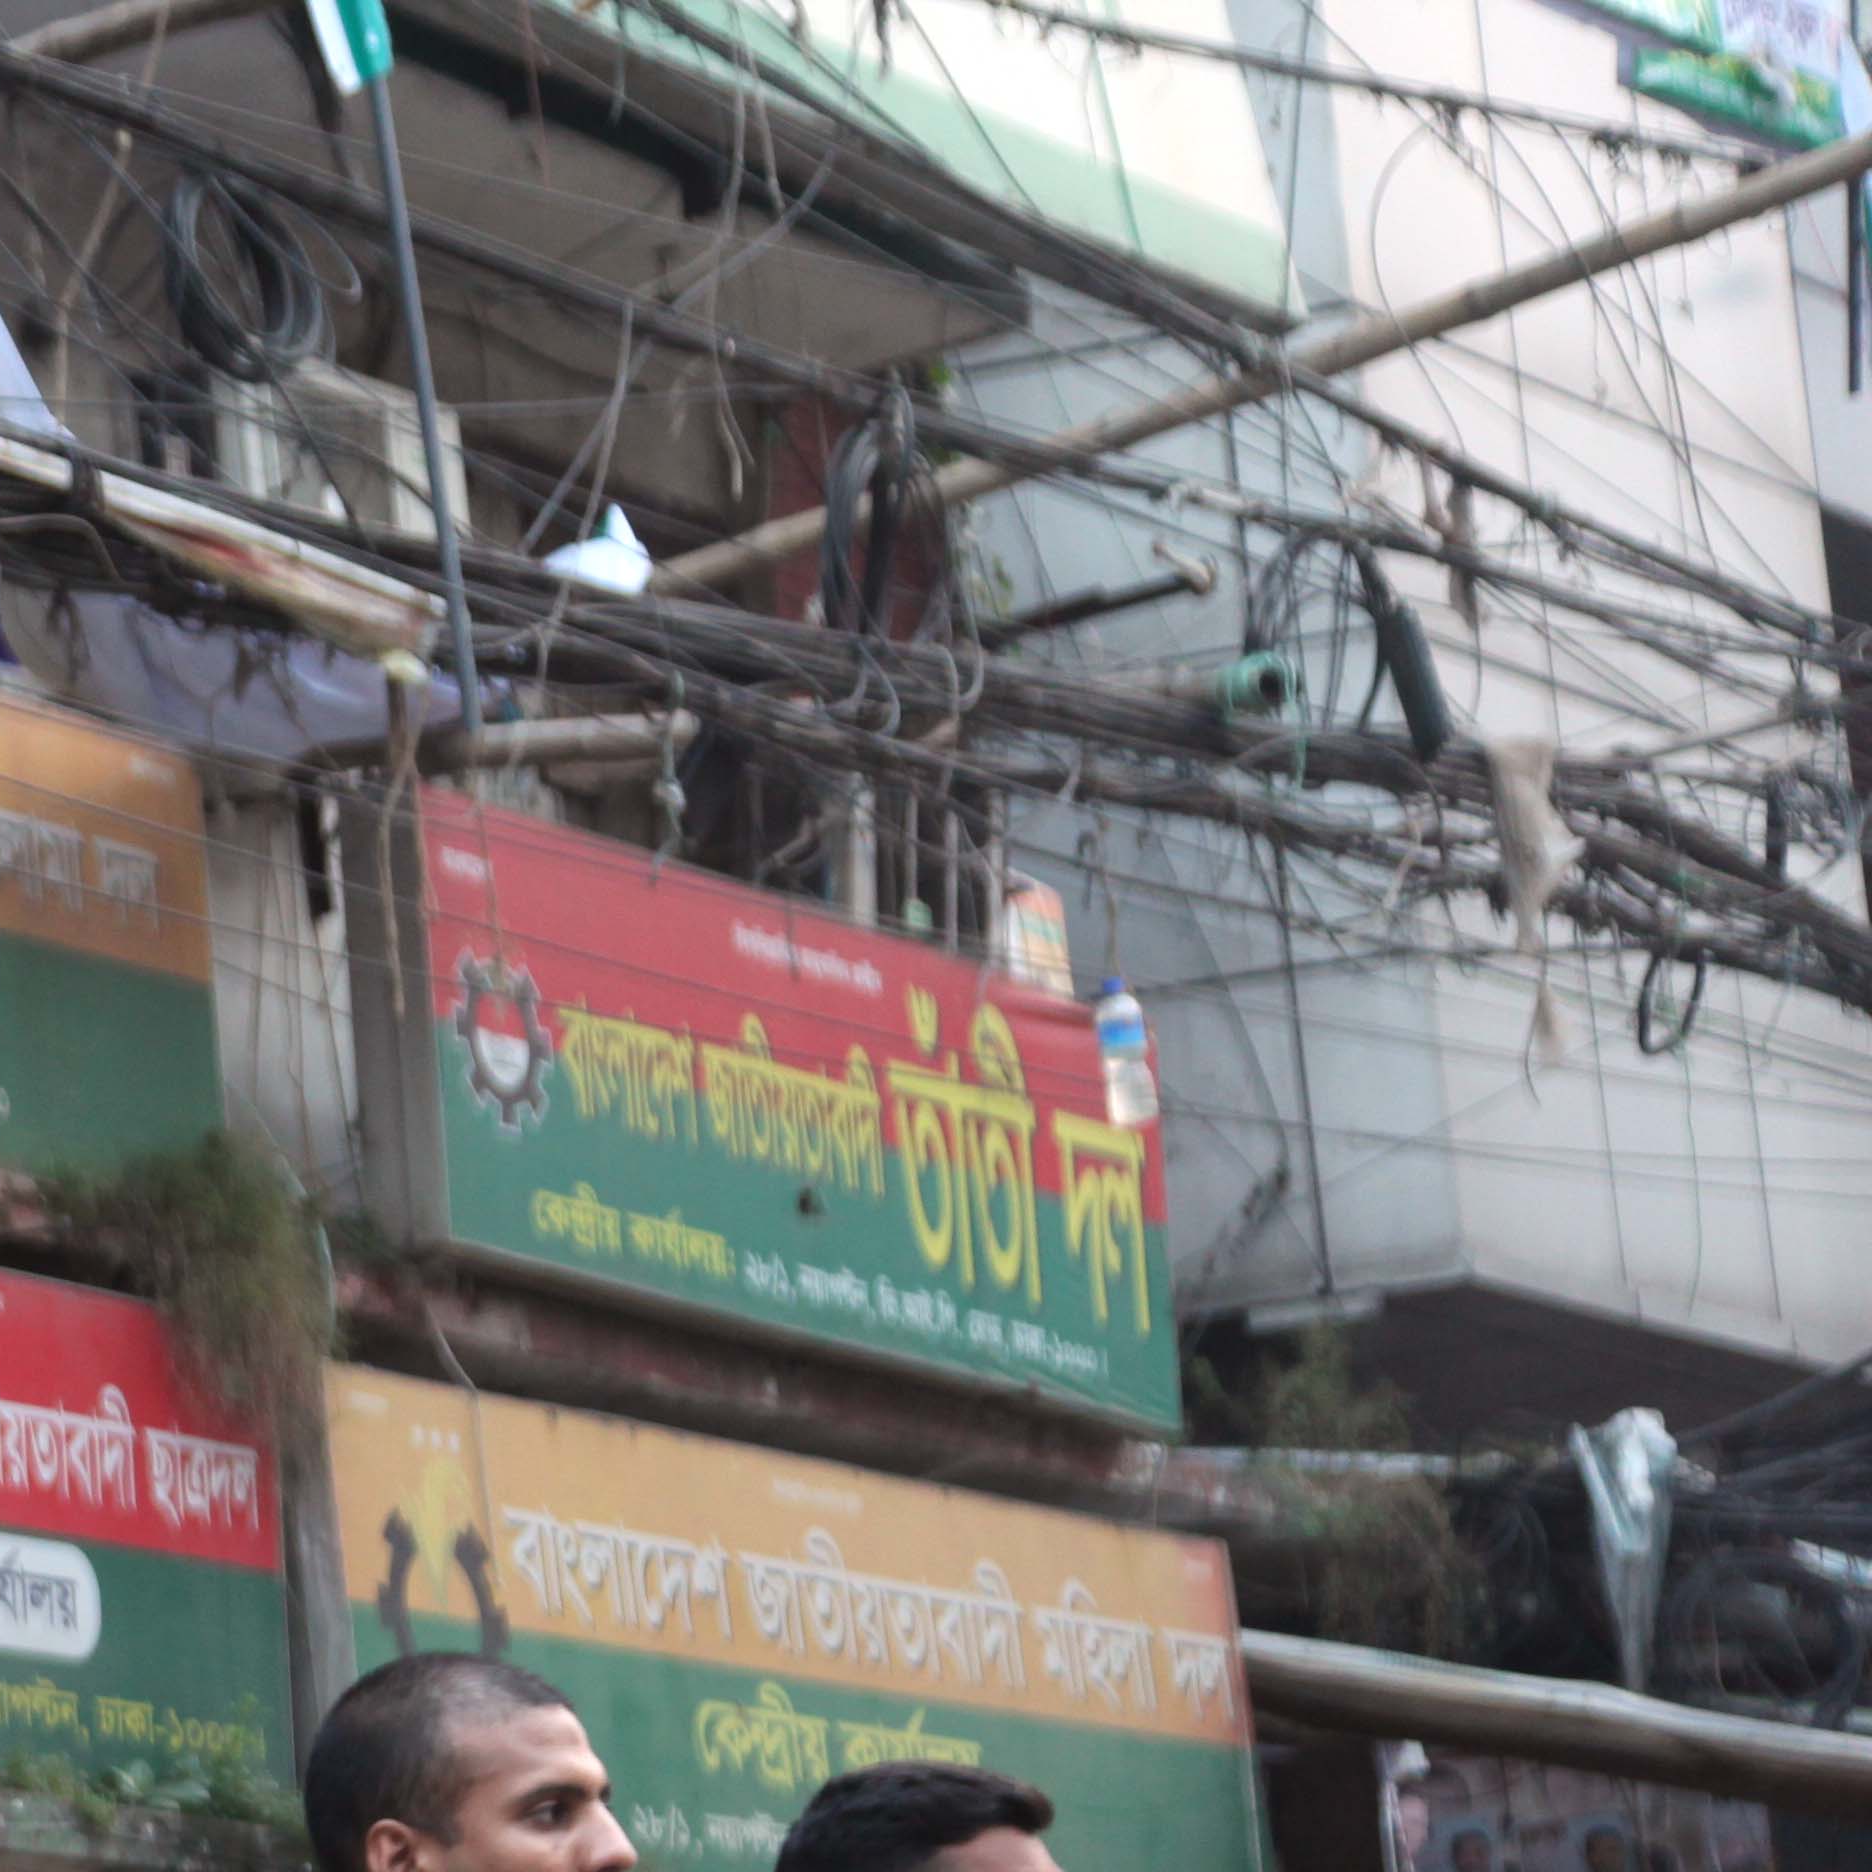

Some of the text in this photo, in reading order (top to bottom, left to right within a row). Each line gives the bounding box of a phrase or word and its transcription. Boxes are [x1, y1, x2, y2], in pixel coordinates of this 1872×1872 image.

[555, 983, 1151, 1340] বাংলাদেশ জাতীয়তাবাদী তাঁতী দল
[144, 1422, 261, 1532] ছাত্রদল
[502, 1504, 1237, 1722] বাংলাদেশ জাতীয়তাবাদী মহিলা দল
[694, 1680, 831, 1792] কেন্দ্রীয়
